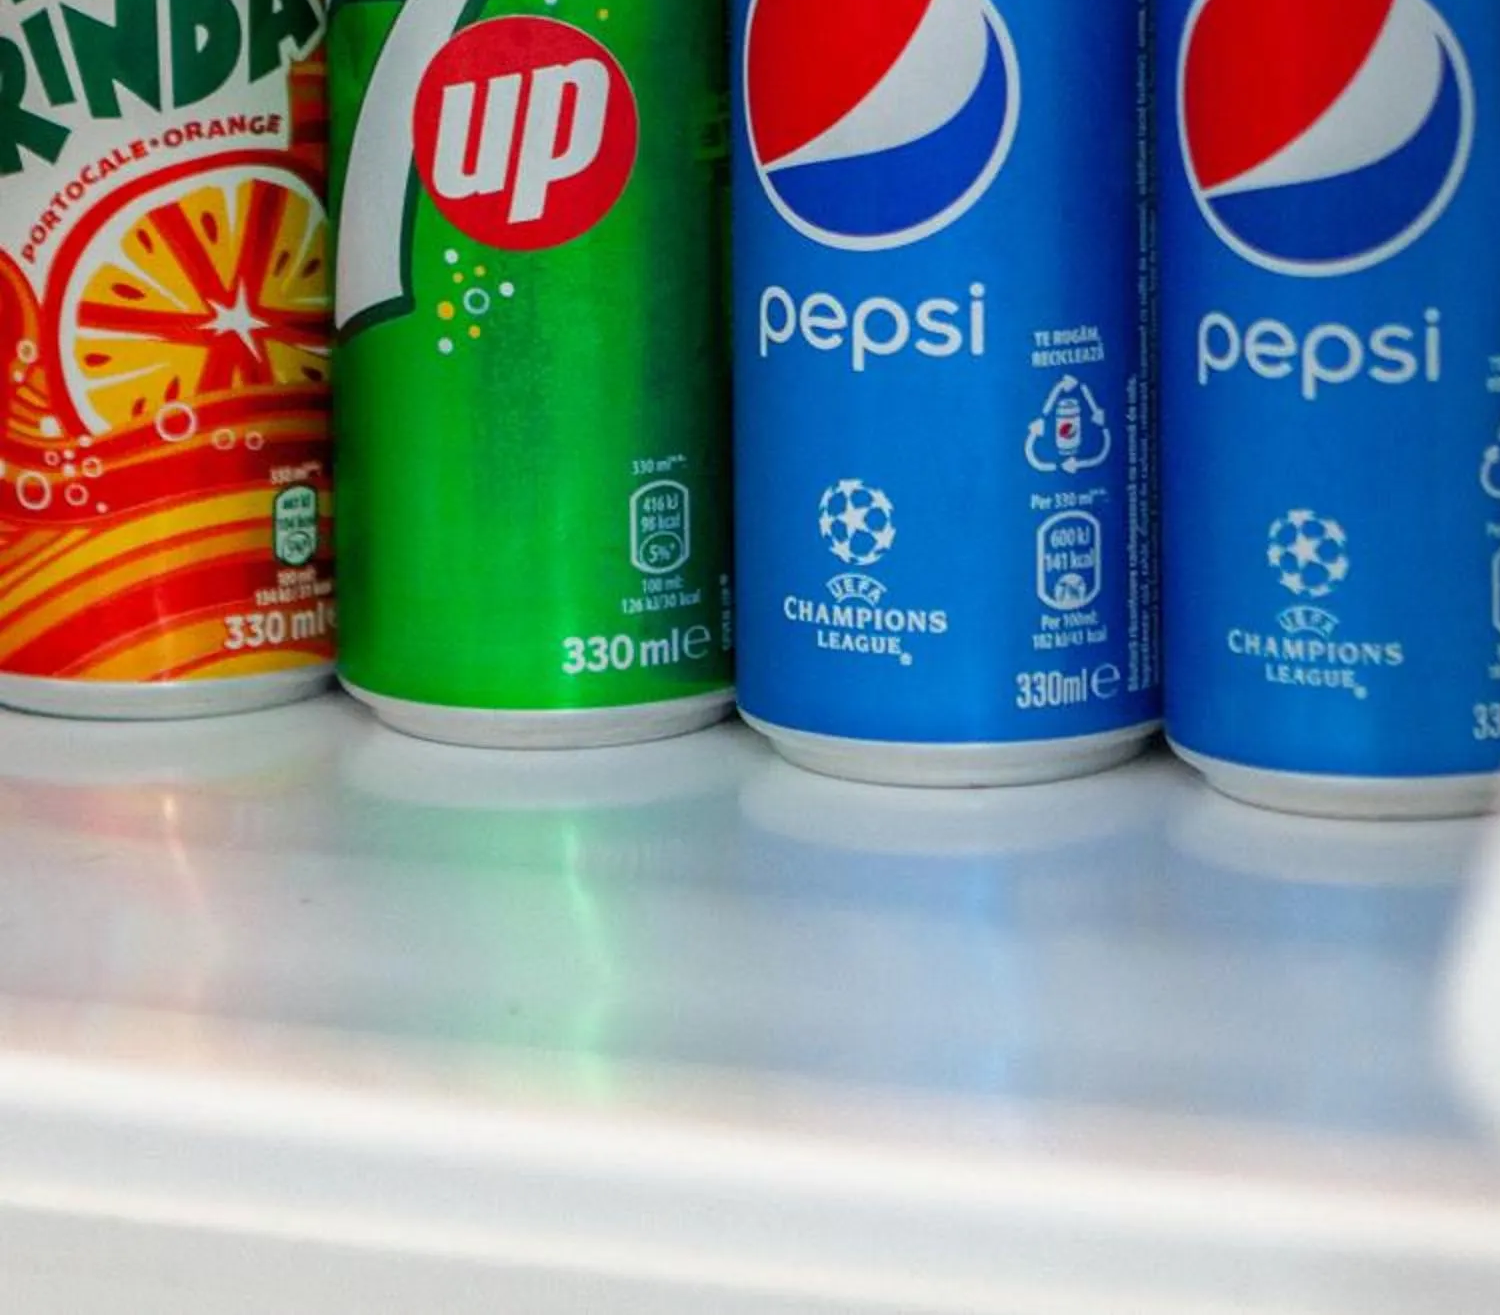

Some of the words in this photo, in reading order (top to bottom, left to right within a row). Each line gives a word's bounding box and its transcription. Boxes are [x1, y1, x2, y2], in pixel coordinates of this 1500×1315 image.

[20, 138, 150, 265] PORTOCALE
[161, 112, 283, 149] ORANGE
[759, 282, 986, 373] pepsi
[1198, 306, 1441, 402] pepsi
[829, 576, 884, 604] UEFA
[223, 609, 286, 650] 330
[290, 601, 325, 640] ml
[783, 595, 949, 634] CHAMPIONS
[561, 634, 634, 675] 330
[639, 627, 680, 667] ml
[1227, 628, 1405, 667] CHAMPIONS
